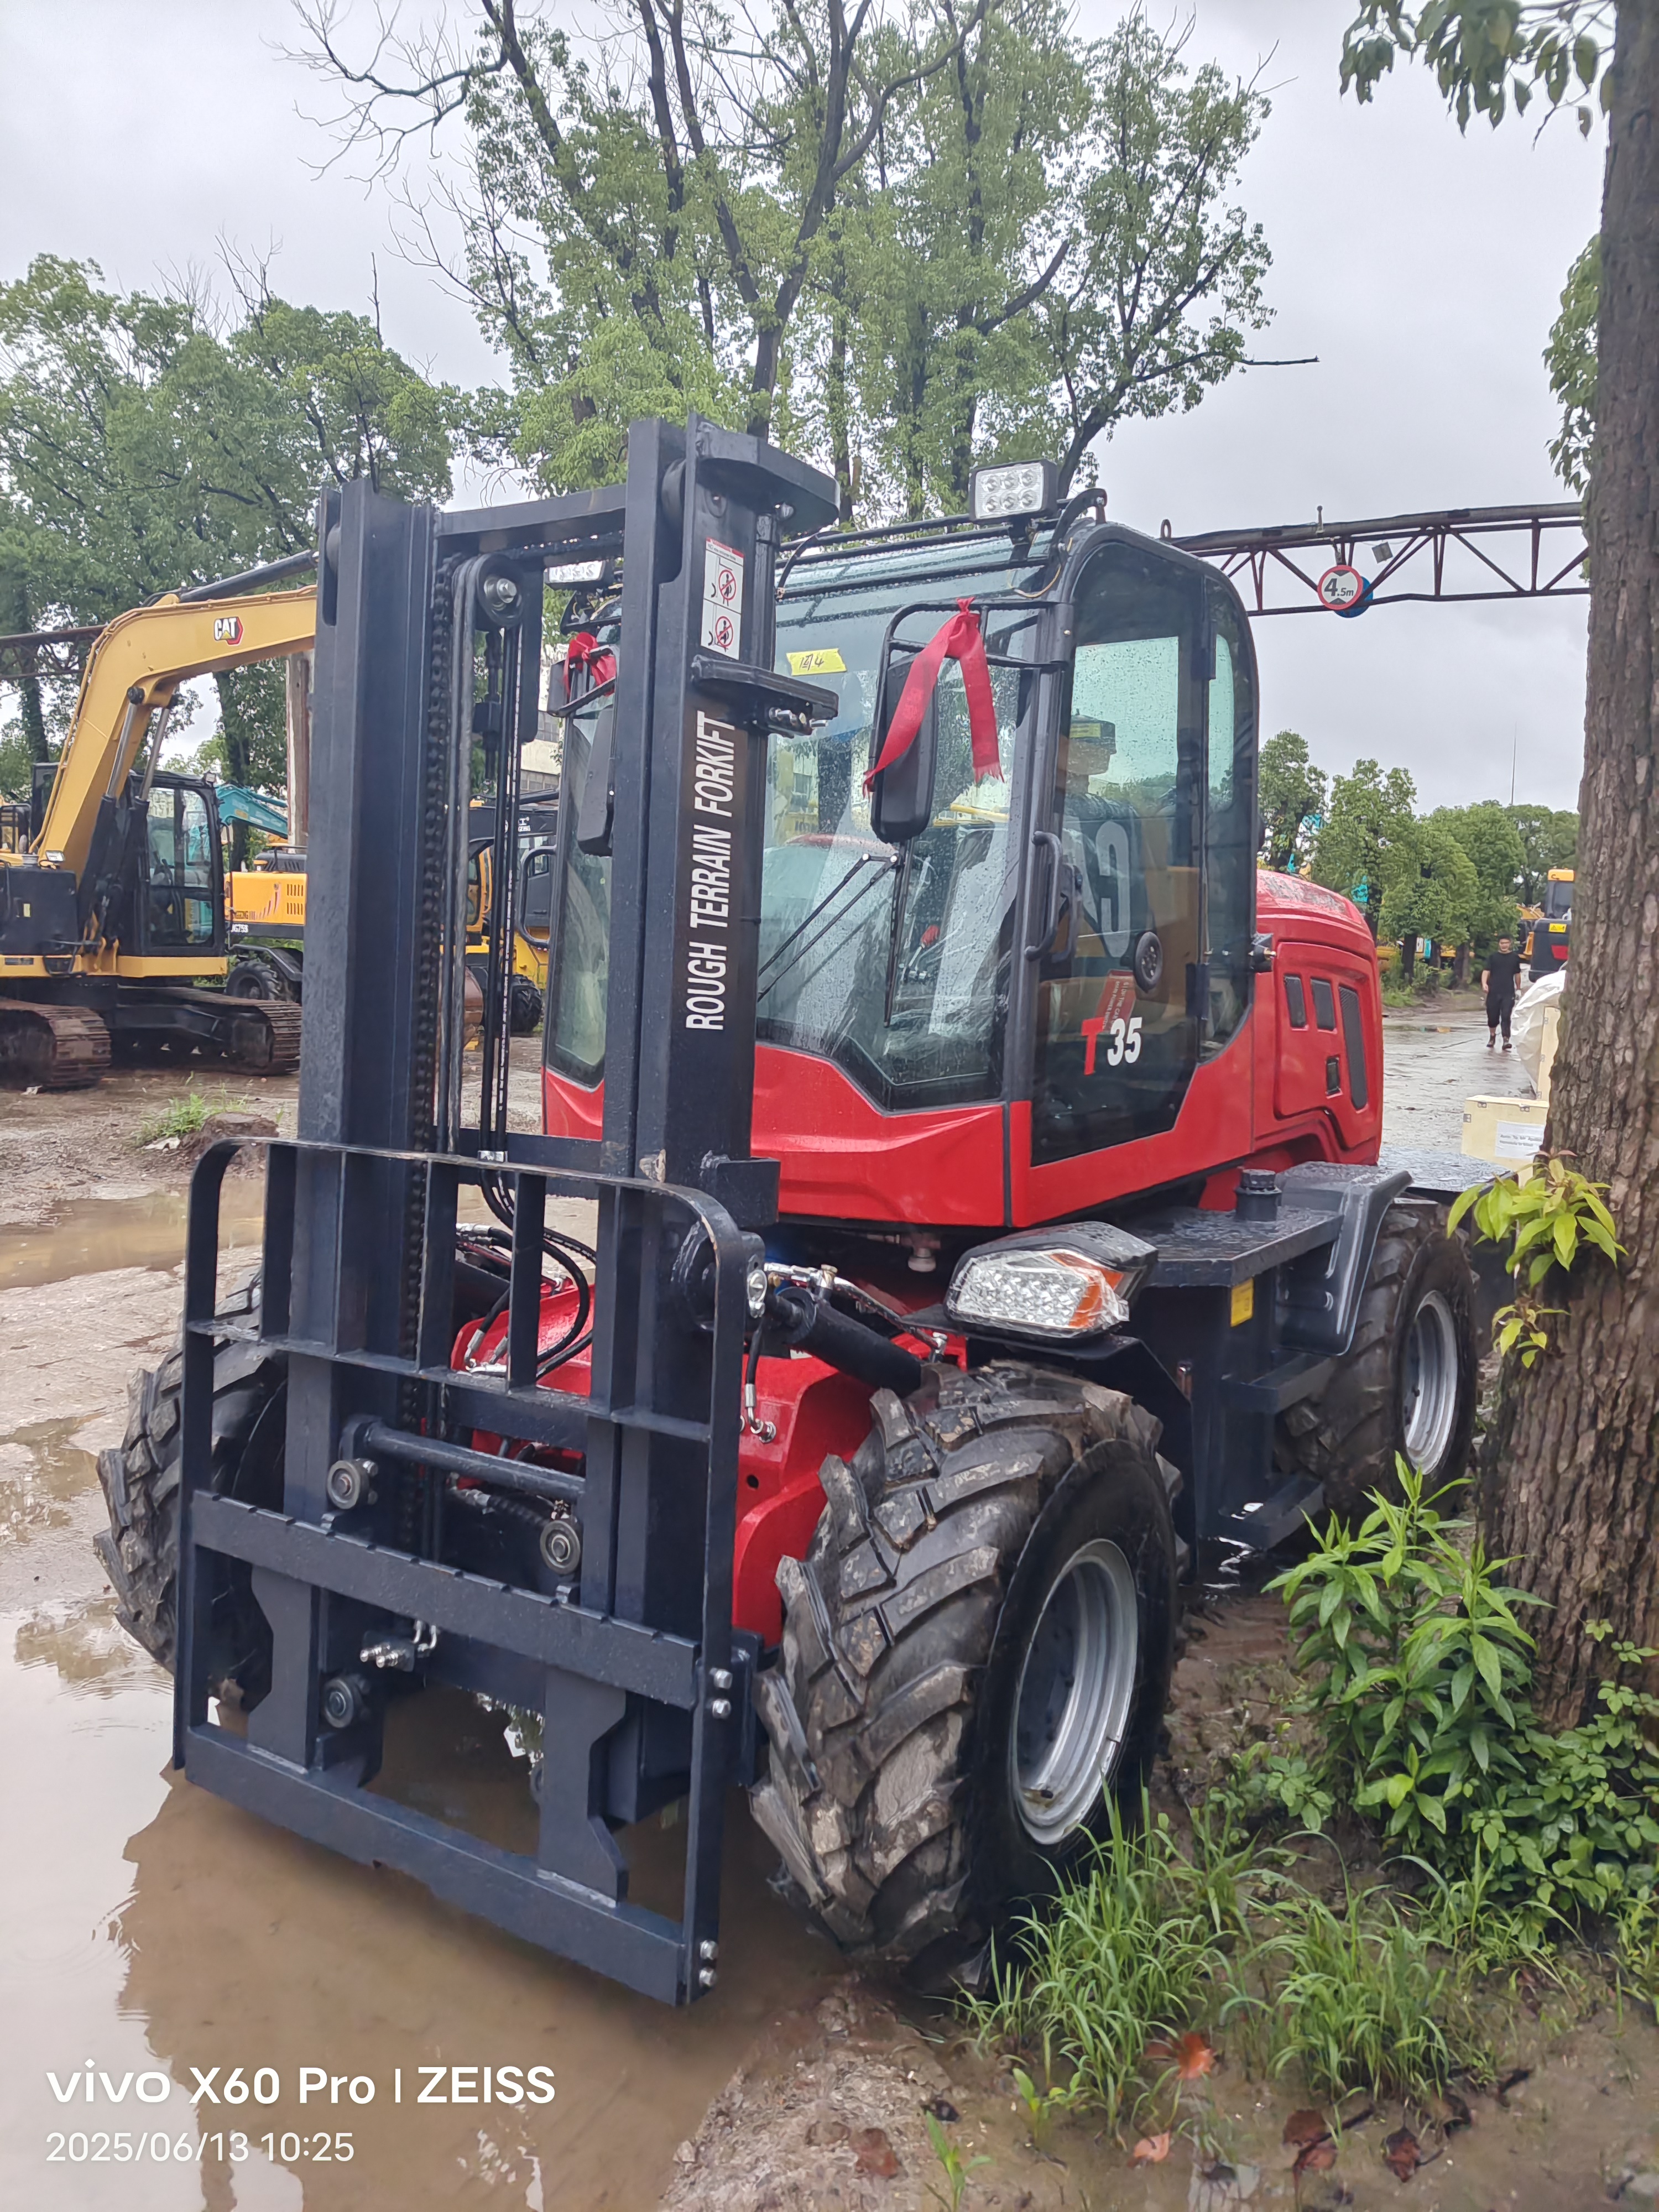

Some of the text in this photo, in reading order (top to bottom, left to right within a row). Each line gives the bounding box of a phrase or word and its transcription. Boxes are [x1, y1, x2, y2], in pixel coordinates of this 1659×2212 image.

[1324, 578, 1354, 597] 4.5m
[215, 617, 237, 640] CAT
[686, 710, 735, 1030] ROUGH TERRAIN FORKIFT
